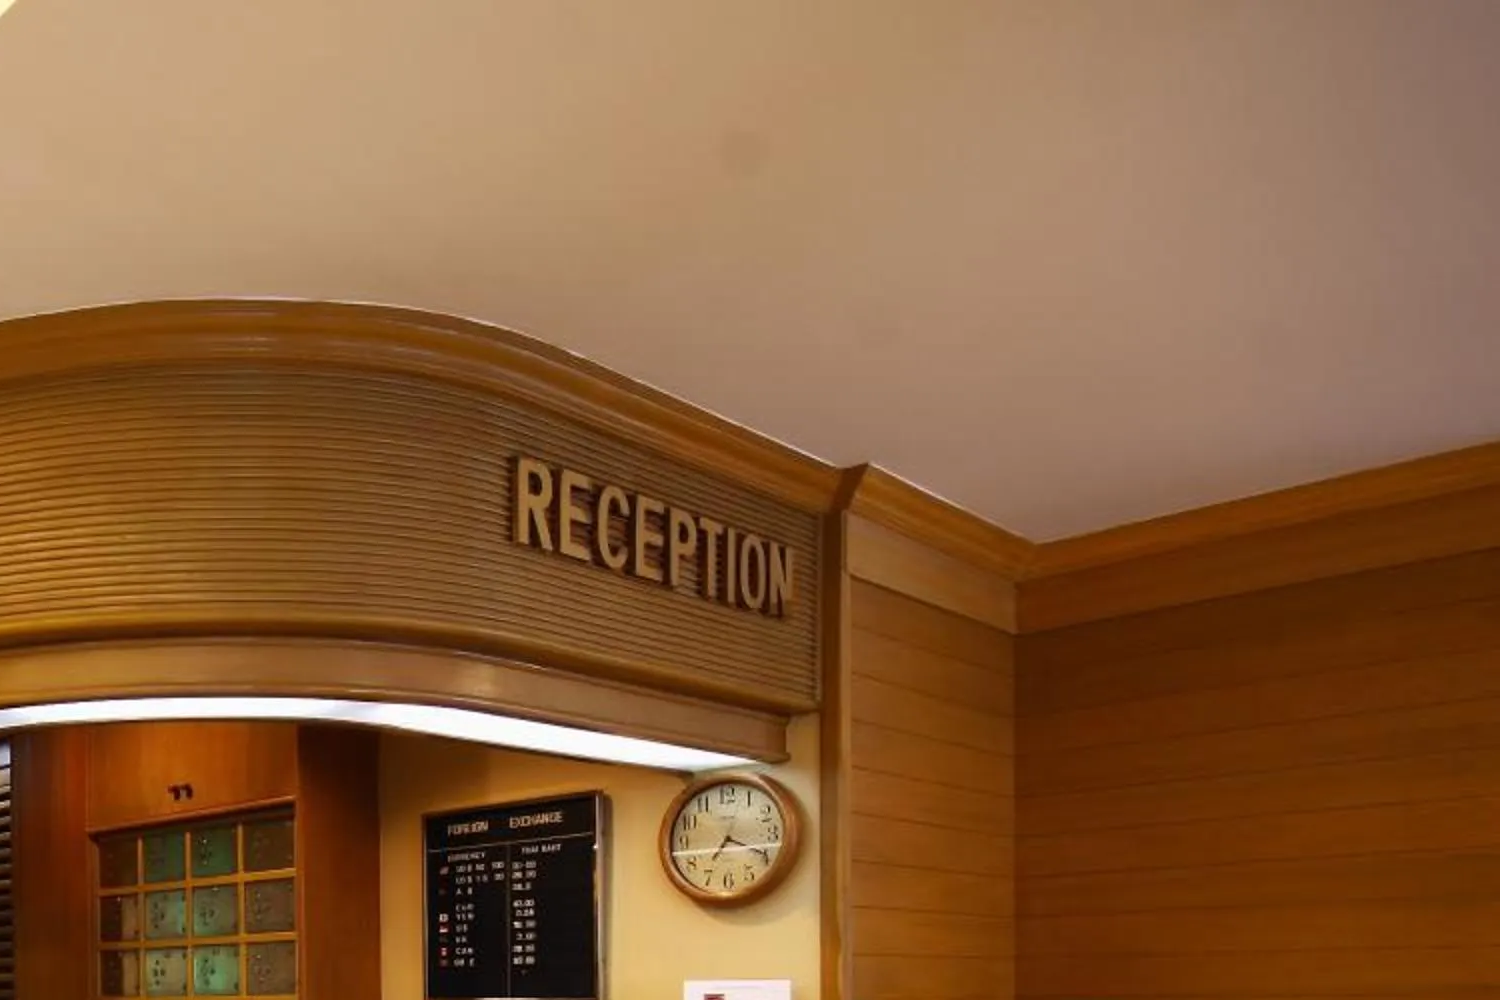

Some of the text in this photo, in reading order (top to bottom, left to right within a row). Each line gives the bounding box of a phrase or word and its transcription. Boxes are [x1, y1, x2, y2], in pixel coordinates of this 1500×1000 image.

[516, 455, 793, 615] RECEPTION
[719, 785, 736, 804] 12
[696, 795, 710, 813] 11
[509, 811, 563, 829] EXCHANGE
[756, 804, 773, 823] 2
[682, 814, 697, 831] 10
[767, 825, 779, 841] 3
[679, 835, 689, 849] 9
[685, 855, 698, 872] 8
[703, 869, 713, 887] 7
[722, 872, 734, 888] 6
[743, 864, 755, 881] 5
